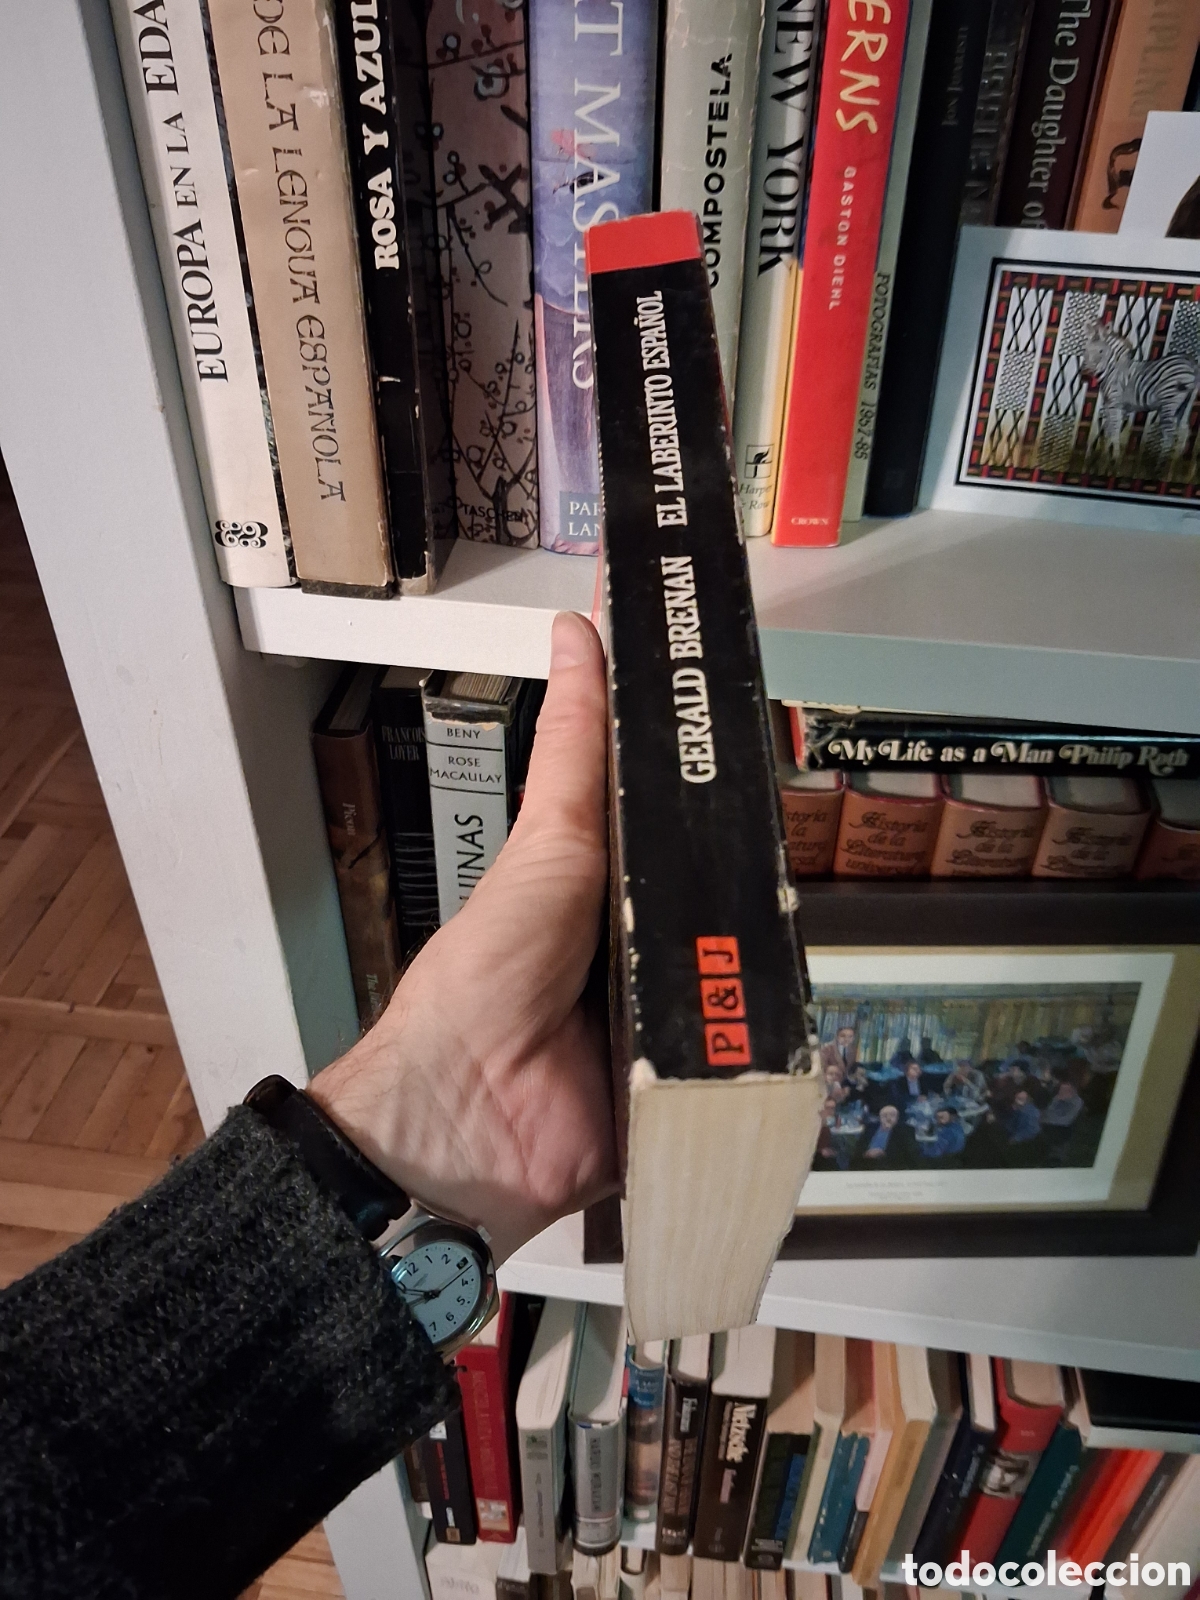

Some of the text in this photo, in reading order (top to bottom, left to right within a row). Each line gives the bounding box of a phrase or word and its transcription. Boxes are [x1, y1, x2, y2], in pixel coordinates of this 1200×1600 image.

[262, 72, 299, 131] LA
[163, 111, 190, 154] LA
[350, 0, 400, 270] ROSA Y AZUL
[1027, 56, 1080, 194] Daughter
[170, 165, 199, 208] EN
[758, 133, 805, 278] YORK
[272, 147, 320, 304] LENGUA
[828, 165, 857, 311] GASTON DIEHL
[173, 219, 229, 383] EUROPA
[633, 290, 689, 528] EL LABERINTO ESPAÑOL
[853, 400, 876, 461] 1957-85
[464, 503, 524, 522] TASCEN
[790, 517, 829, 526] CROWN
[568, 522, 602, 537] LAN
[660, 555, 717, 784] GERALD BRENAN
[446, 728, 481, 739] BENY
[448, 756, 481, 768] ROSE
[828, 738, 1190, 777] My Life as a Man Philip Roth
[430, 768, 502, 784] MACAULAY
[406, 1261, 419, 1277] 12
[424, 1254, 433, 1264] 1
[441, 1253, 451, 1265] 2
[461, 1278, 469, 1287] 4
[456, 1295, 466, 1306] 5
[428, 1321, 437, 1332] 7
[445, 1311, 455, 1322] 6
